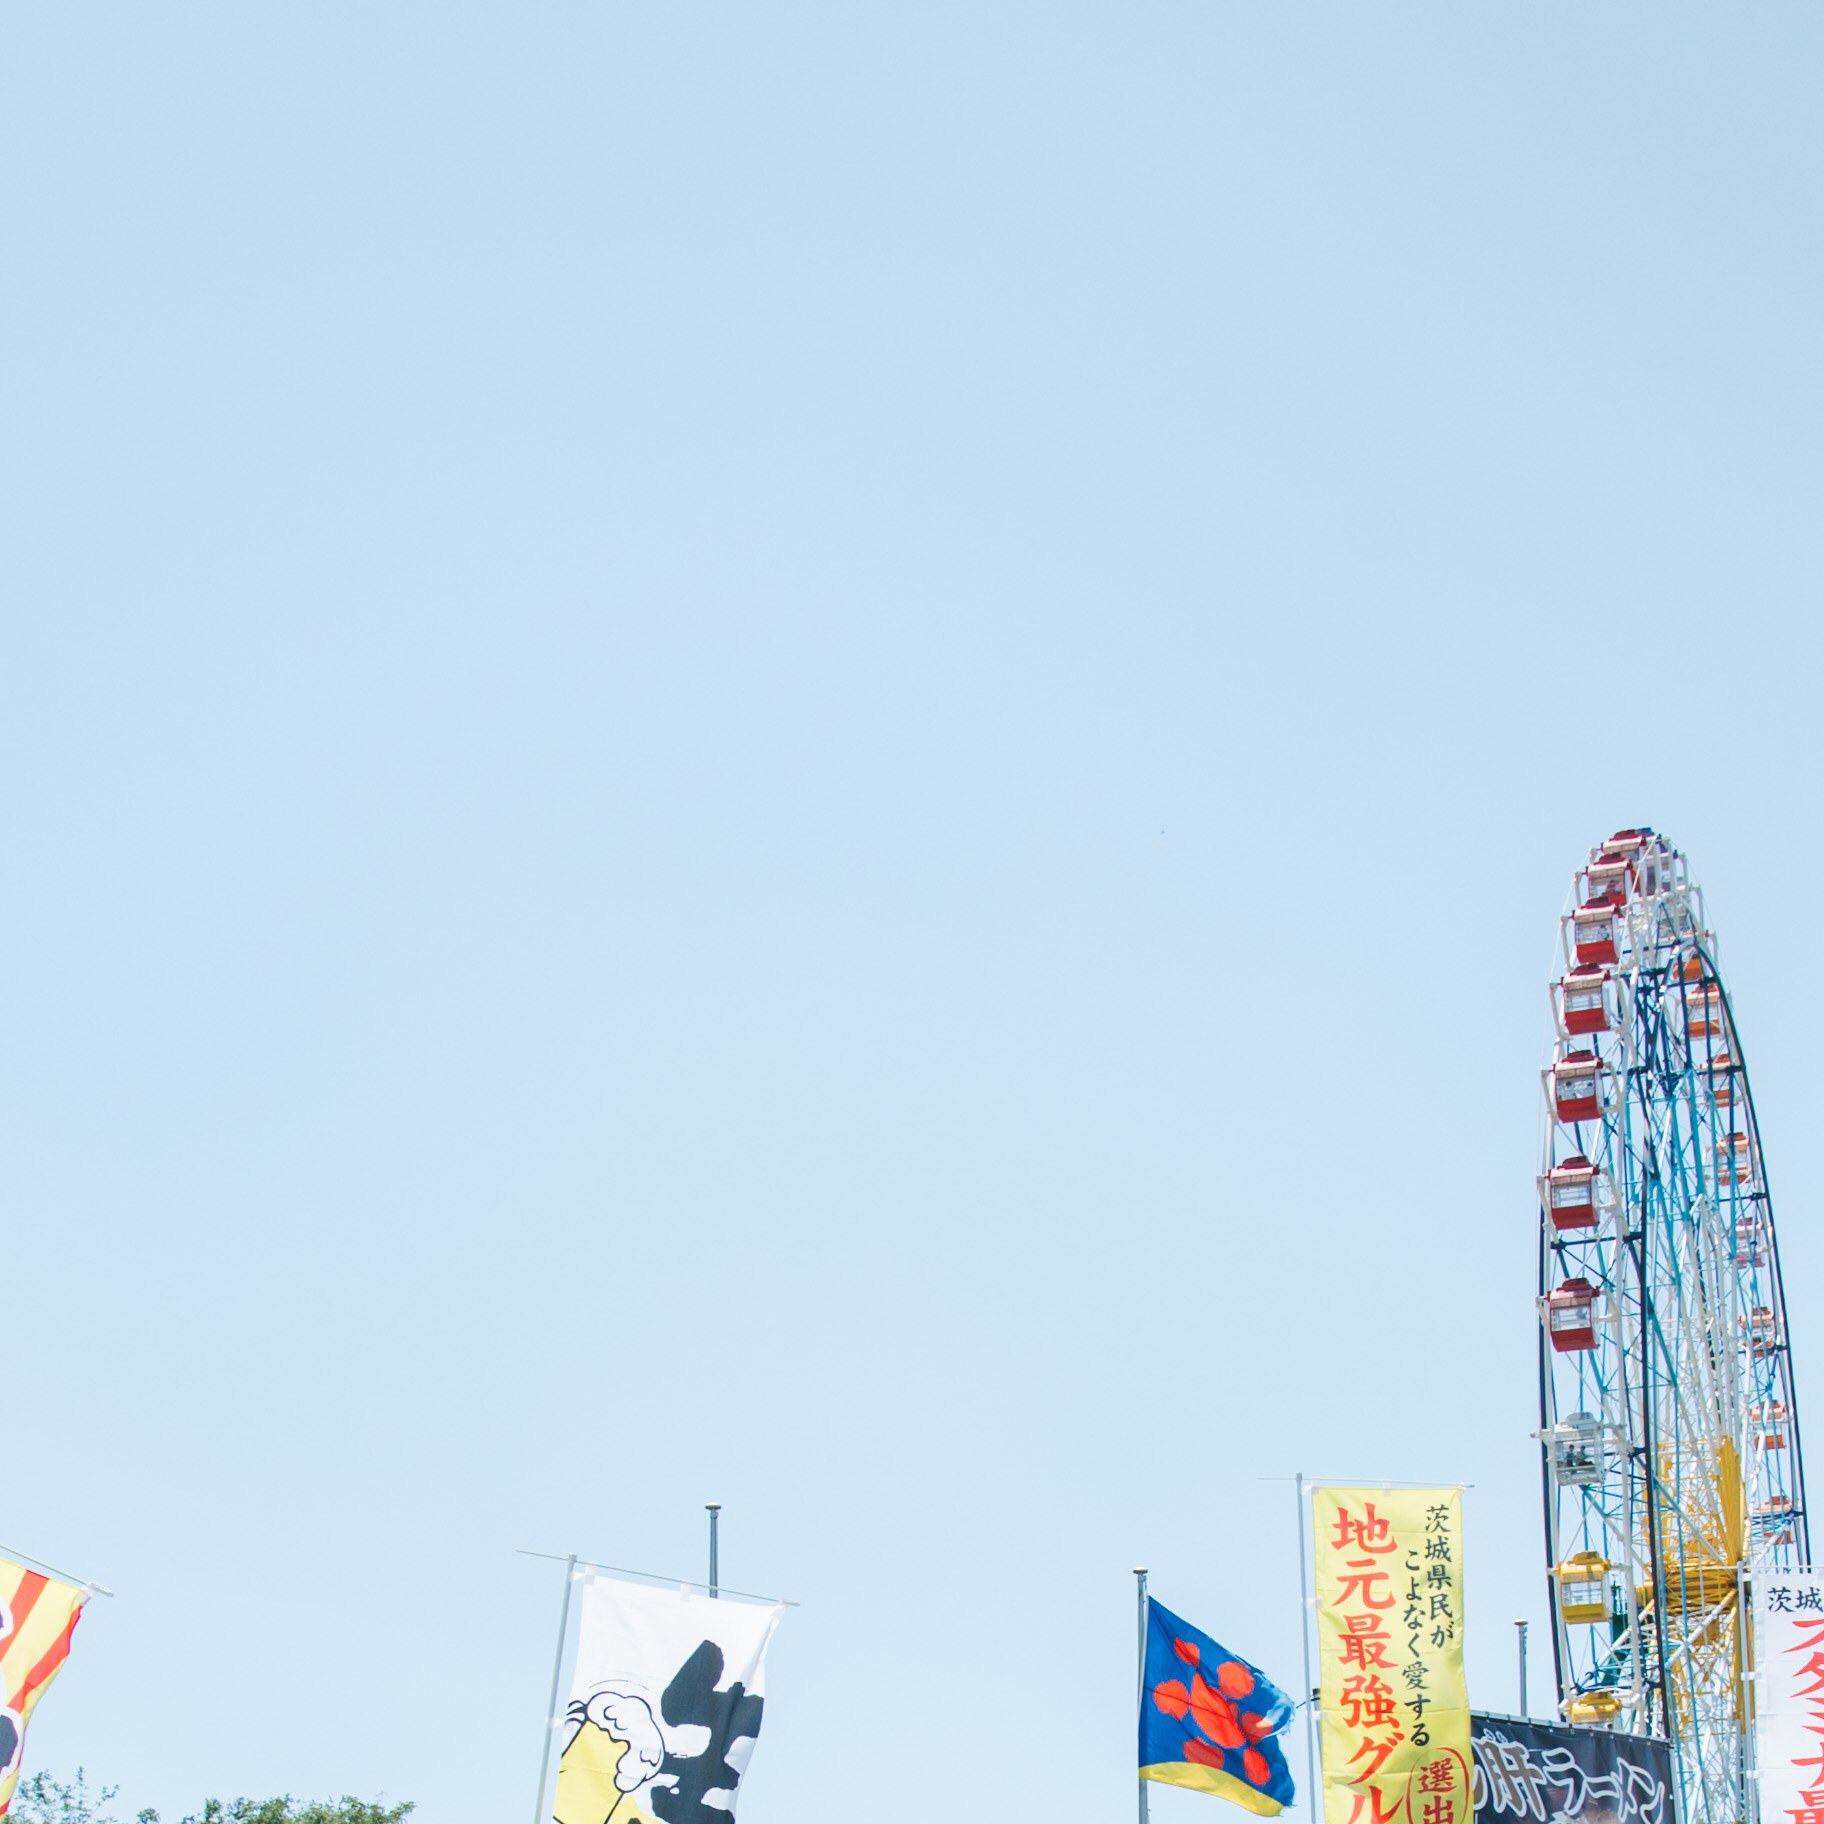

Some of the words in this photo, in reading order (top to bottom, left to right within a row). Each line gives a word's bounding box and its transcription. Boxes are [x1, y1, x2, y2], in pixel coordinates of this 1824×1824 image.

[1402, 1550, 1431, 1747] こよなく愛する
[1425, 1504, 1455, 1649] 茨城県民が
